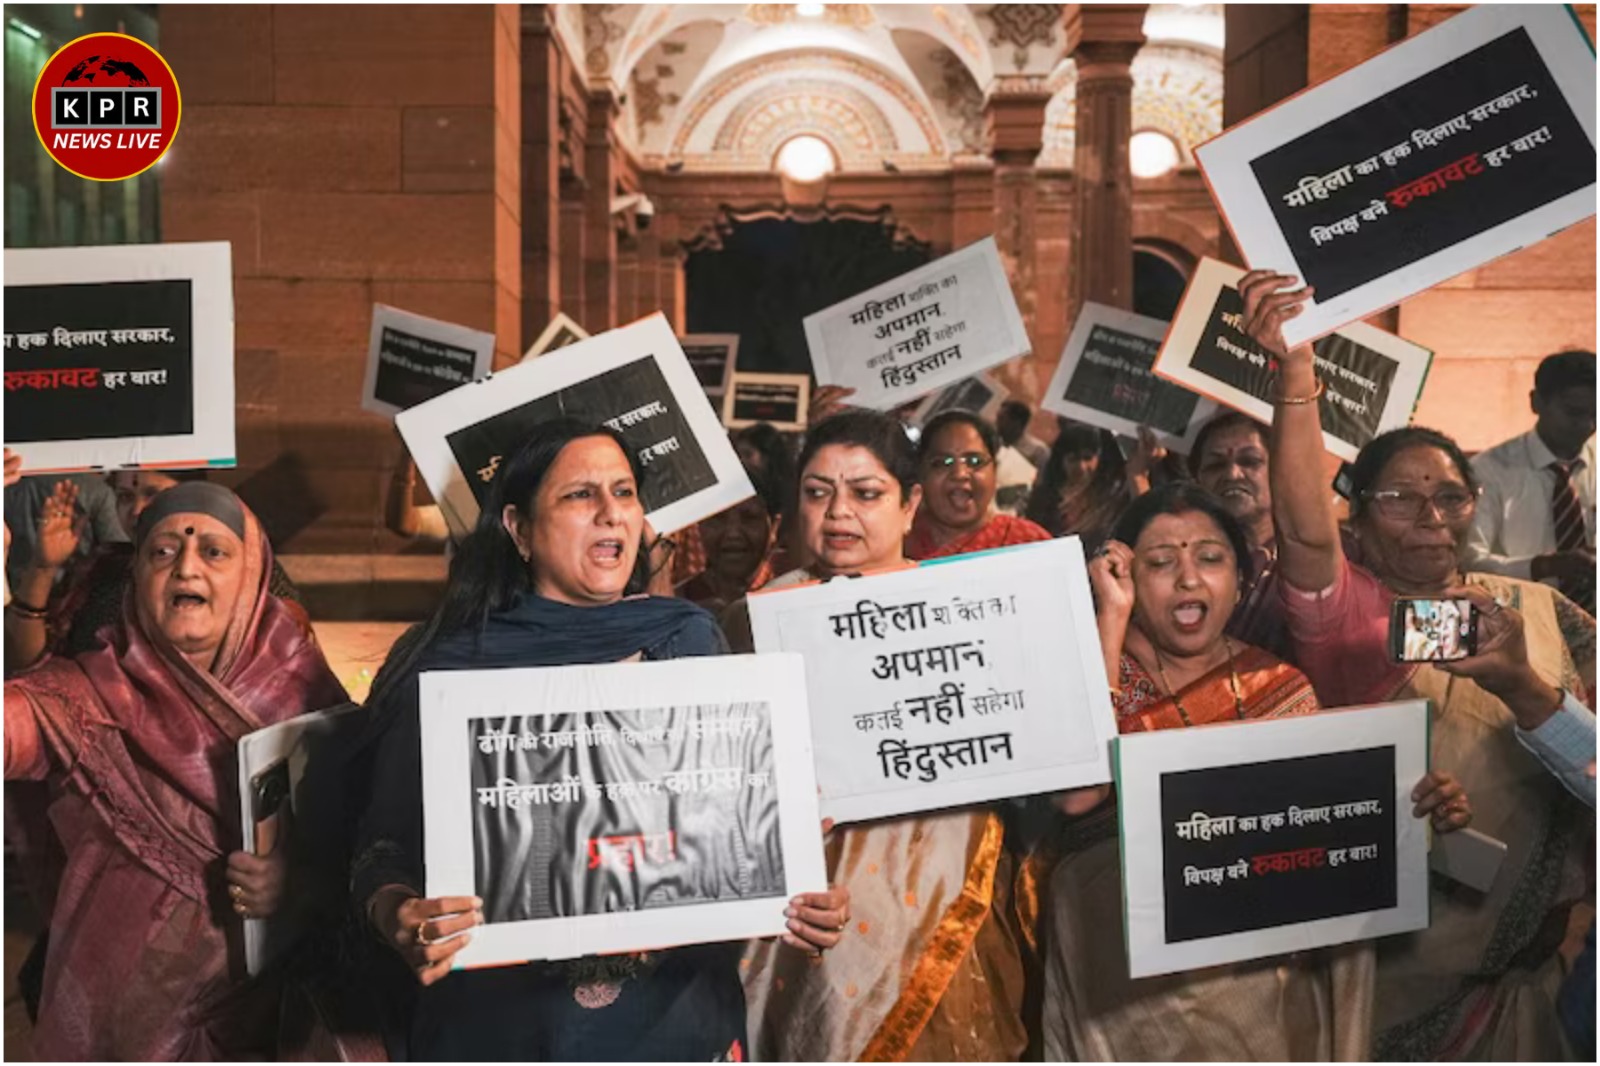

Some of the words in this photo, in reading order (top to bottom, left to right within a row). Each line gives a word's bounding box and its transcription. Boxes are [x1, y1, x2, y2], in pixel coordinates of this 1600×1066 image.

[1283, 165, 1354, 207] महिला
[1353, 155, 1380, 175] का
[1379, 141, 1412, 167] हक
[1411, 113, 1472, 150] दिलाए
[1467, 84, 1539, 121] सरकार,
[1310, 213, 1360, 247] विपक्ष
[1384, 152, 1486, 208] रुकावट
[1483, 145, 1512, 167] हर
[849, 292, 906, 325] महिला
[17, 332, 48, 350] हक
[53, 326, 108, 348] दिलाए
[110, 327, 175, 344] सरकार,
[895, 326, 931, 354] नहीं
[4, 367, 100, 390] रुकावट
[103, 372, 126, 388] हर
[881, 344, 962, 389] हिंदुस्तान
[619, 400, 668, 427] सरकार,
[829, 599, 928, 640] महिला
[853, 701, 903, 733] कतई
[904, 682, 966, 725] नहीं
[969, 687, 1024, 716] सहेगा
[477, 728, 516, 754] ढोंग
[877, 732, 1013, 782] हिंदुस्तान
[477, 775, 580, 811] महिलाओं
[1175, 811, 1237, 841] महिला
[1238, 815, 1258, 832] का
[1259, 812, 1285, 832] हक
[1288, 805, 1332, 827] दिलाए
[1333, 800, 1383, 819] सरकार,
[1184, 865, 1225, 886] विपक्ष
[1251, 847, 1326, 876] रुकावट
[1327, 849, 1348, 867] हर
